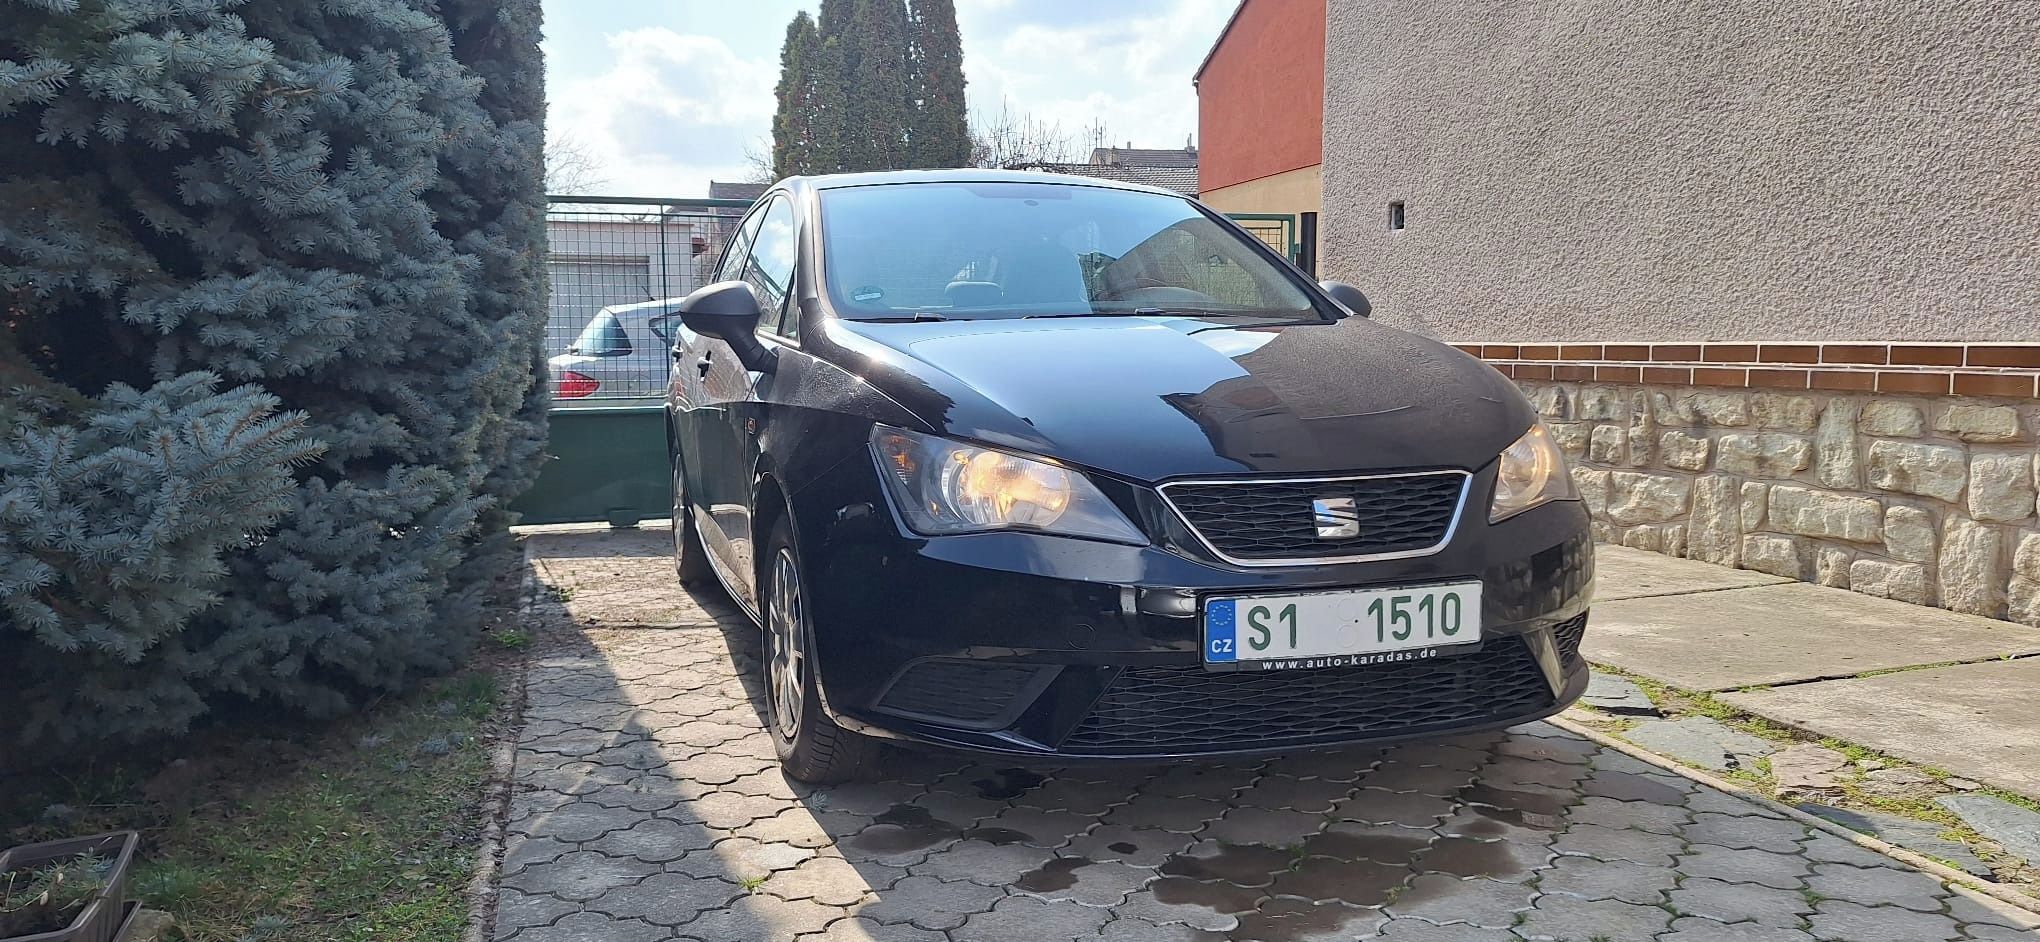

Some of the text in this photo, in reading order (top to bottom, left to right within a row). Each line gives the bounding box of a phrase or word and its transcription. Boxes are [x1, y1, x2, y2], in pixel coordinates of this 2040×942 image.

[1247, 592, 1461, 651] S1 1510
[1211, 638, 1233, 653] CZ
[1262, 647, 1437, 670] www.auto-karadas.de
